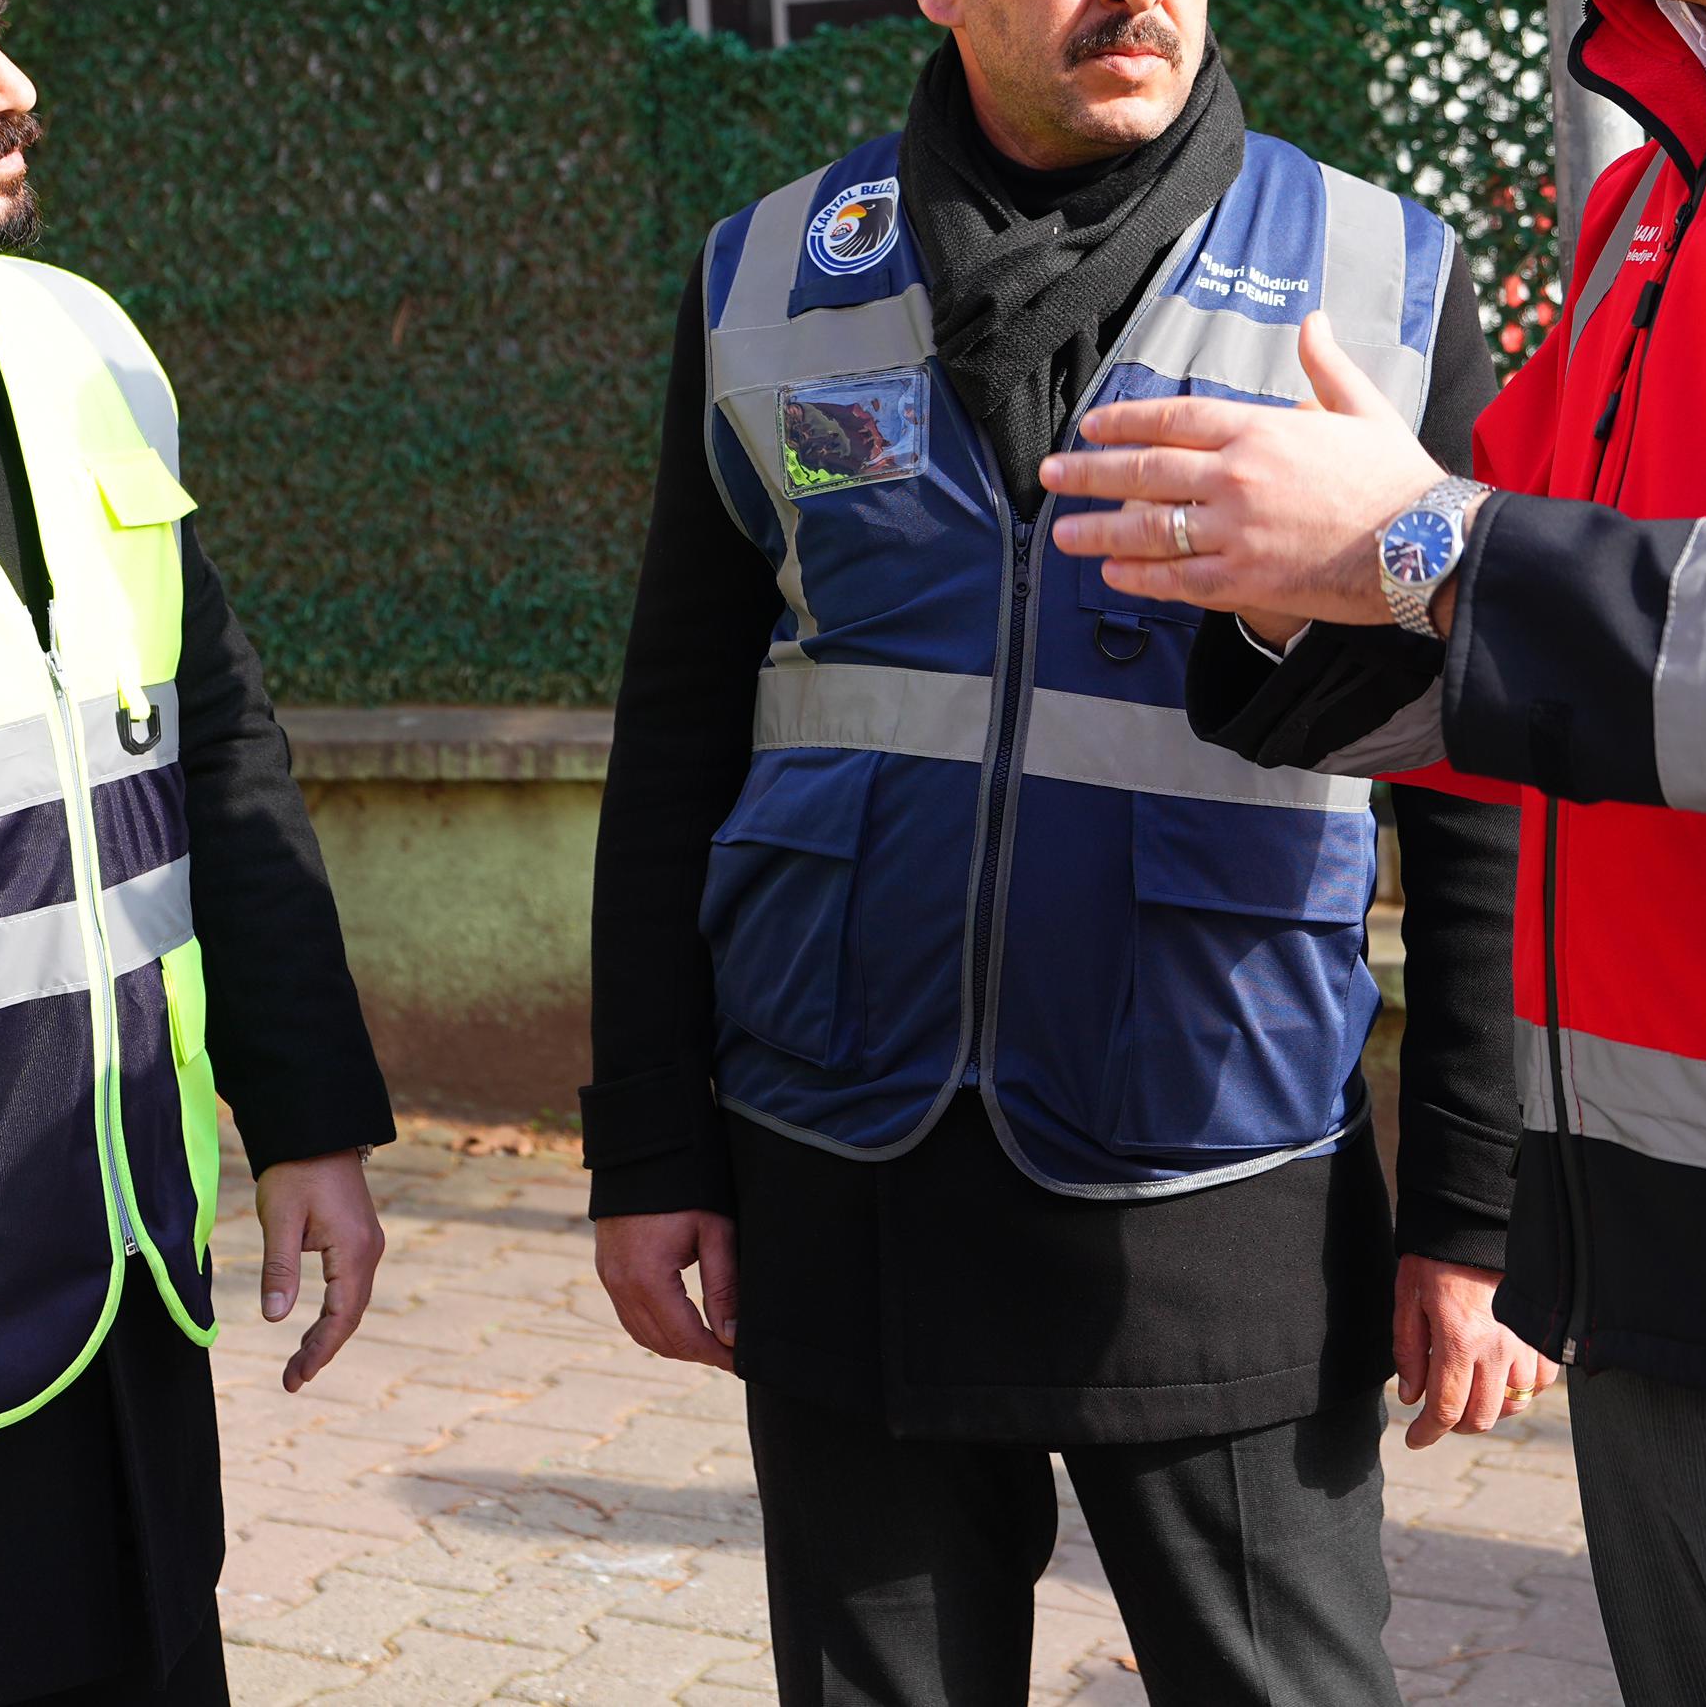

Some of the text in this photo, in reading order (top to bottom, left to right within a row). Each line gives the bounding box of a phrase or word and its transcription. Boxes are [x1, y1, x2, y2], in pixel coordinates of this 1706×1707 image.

[811, 190, 857, 234] KARTAL
[1234, 279, 1287, 307] DEMİR
[1248, 266, 1309, 293] Müdürü
